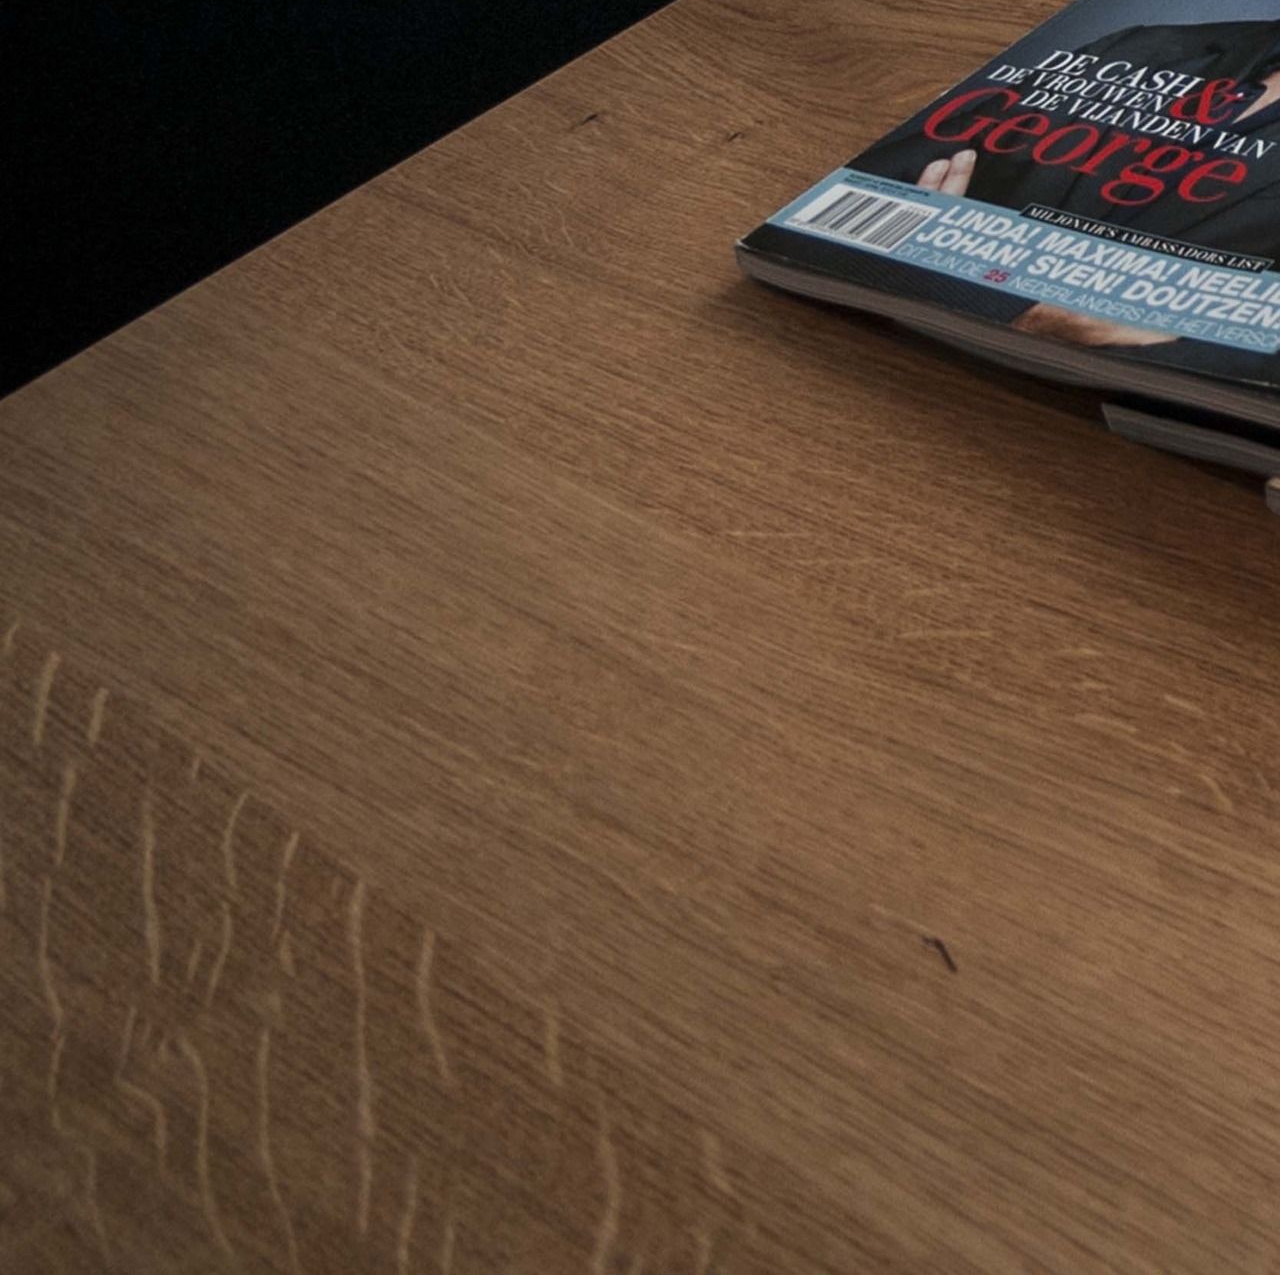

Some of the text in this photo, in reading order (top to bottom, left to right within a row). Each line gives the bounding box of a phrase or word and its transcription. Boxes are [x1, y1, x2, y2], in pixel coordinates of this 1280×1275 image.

[987, 64, 1177, 114] DE VROUWEN
[1034, 50, 1099, 76] DE
[1095, 60, 1206, 100] CASH
[923, 87, 1249, 207] George
[1020, 89, 1279, 161] DE VIJANDEN VAN
[915, 223, 1031, 268] JOHAN!
[1028, 253, 1123, 294] SVEN!
[938, 205, 1037, 246] LINDA!
[1038, 228, 1177, 280] MAXIMA!
[1028, 206, 1267, 271] MILJONAIR'S AMBASSADORS LIST
[899, 242, 928, 262] DIT
[927, 250, 962, 272] ZIJN
[962, 258, 986, 276] DE
[1010, 276, 1144, 324] NEDERLANDERS
[1144, 306, 1176, 326] DIE
[1178, 314, 1214, 334] HET
